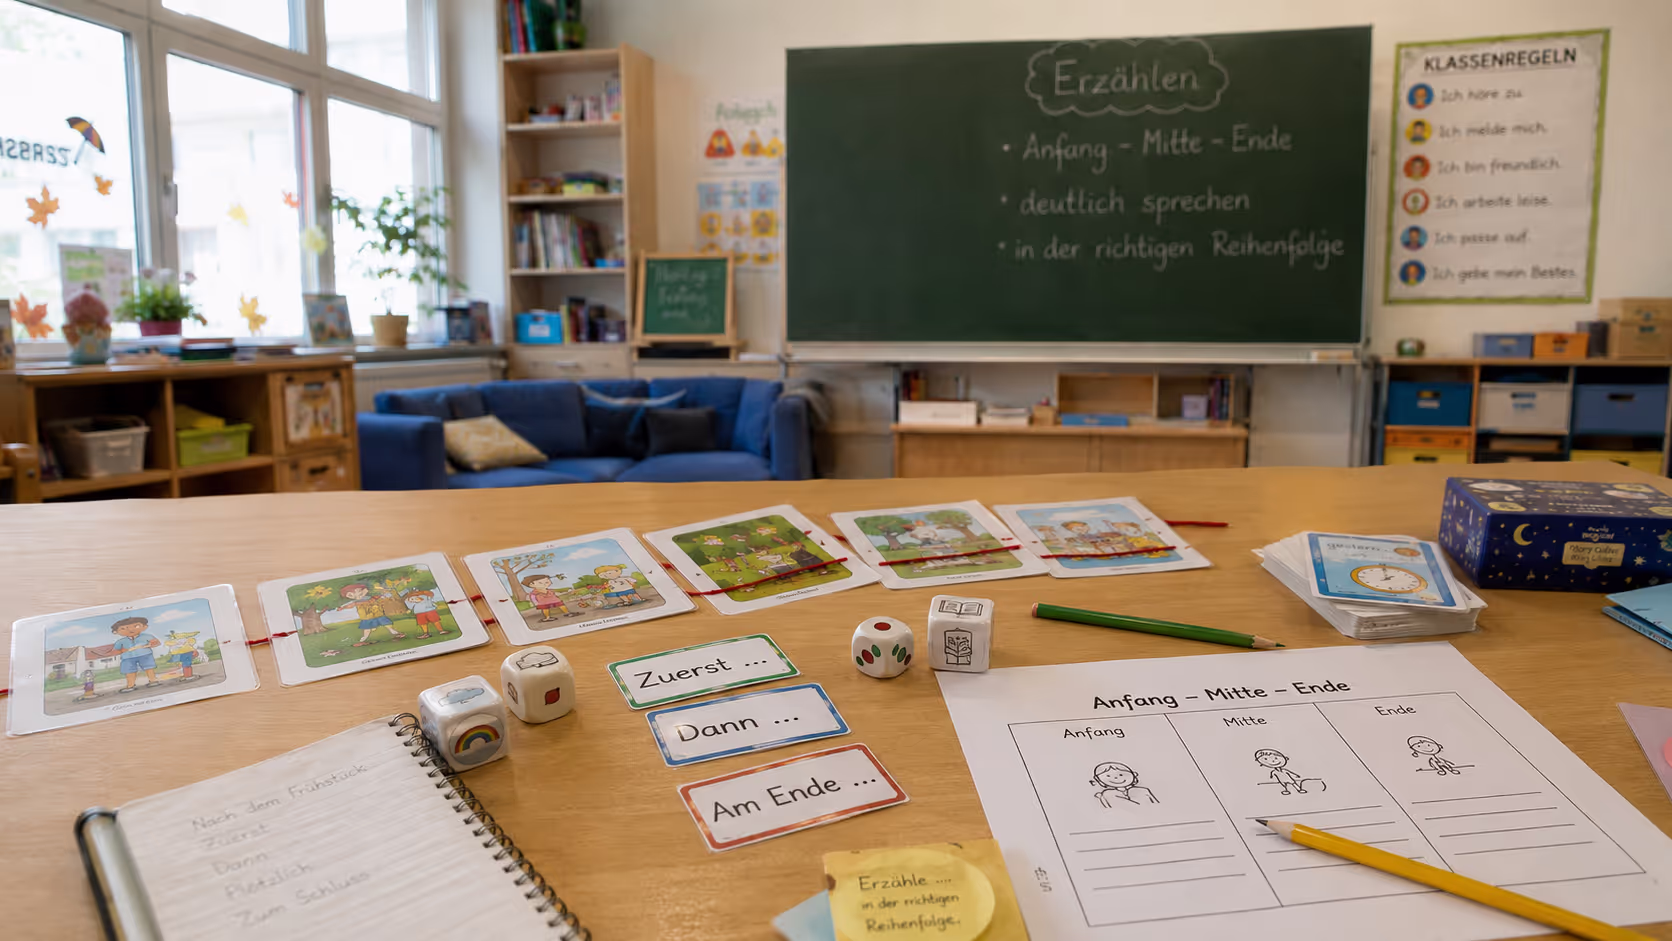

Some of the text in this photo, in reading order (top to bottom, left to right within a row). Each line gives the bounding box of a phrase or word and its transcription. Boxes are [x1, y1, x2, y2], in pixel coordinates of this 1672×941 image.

[1423, 47, 1577, 72] KLASSENREGELN
[1053, 58, 1199, 96] Erzählen
[1441, 87, 1464, 103] Ich
[1439, 125, 1461, 139] Ich
[1465, 122, 1507, 137] melde
[1022, 132, 1108, 175] Anfang
[1142, 127, 1204, 157] Mitte
[1230, 122, 1293, 153] Ende
[1437, 160, 1460, 175] Ich
[1464, 159, 1487, 174] bin
[1019, 184, 1250, 226] deutlich sprechen
[1435, 195, 1458, 210] Ich
[1462, 193, 1512, 209] arbeite
[1014, 227, 1345, 271] in der richtigen Reihenfolge
[1434, 231, 1457, 246] Ich
[1433, 265, 1455, 280] Ich
[1458, 266, 1489, 285] gebe
[1493, 267, 1527, 280] mein
[634, 657, 733, 689] Zuerst
[1092, 693, 1179, 711] Anfang
[1203, 685, 1268, 702] Mitte
[1291, 679, 1351, 696] Ende
[1222, 715, 1268, 728] Mitte
[1373, 704, 1417, 717] Ende
[674, 715, 760, 743] Dann
[1063, 726, 1126, 741] Anfang
[713, 800, 762, 823] Am
[766, 777, 843, 807] Ende
[191, 808, 237, 832] Nach
[246, 797, 281, 815] dem
[210, 851, 269, 876] Dann
[858, 872, 929, 891] Erzähle
[235, 870, 370, 928] Zum Schluss
[878, 896, 899, 909] der
